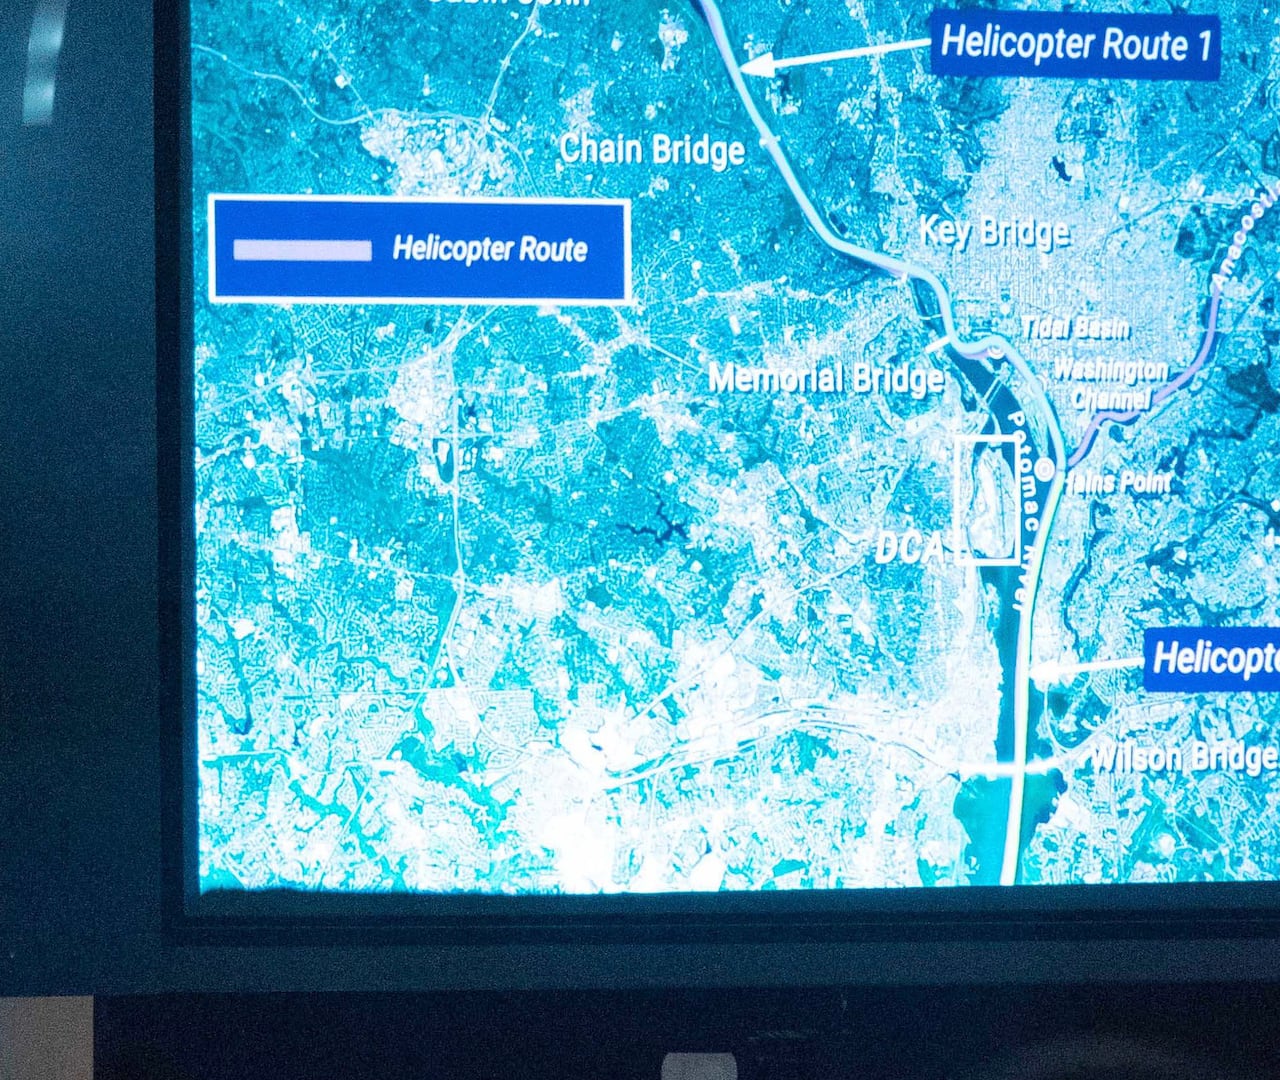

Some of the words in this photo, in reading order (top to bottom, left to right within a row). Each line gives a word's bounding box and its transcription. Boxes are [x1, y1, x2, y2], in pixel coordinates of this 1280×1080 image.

[941, 23, 1096, 66] Helicopter
[1103, 27, 1188, 61] Route
[1199, 30, 1211, 61] 1
[560, 132, 642, 164] Chain
[653, 133, 745, 172] Bridge
[919, 213, 972, 251] Key
[980, 214, 1070, 252] Bridge
[393, 233, 515, 267] Helicopter
[519, 235, 588, 262] Route
[1021, 315, 1072, 338] Tidal
[1075, 315, 1131, 339] Basin
[708, 361, 843, 393] Memorial
[853, 361, 946, 399] Bridge
[1054, 356, 1170, 386] Washington
[1071, 386, 1152, 411] Channel
[1120, 470, 1172, 494] Point
[874, 531, 945, 564] DCA
[1091, 740, 1182, 773] Wilson
[1192, 740, 1278, 777] Bridge
